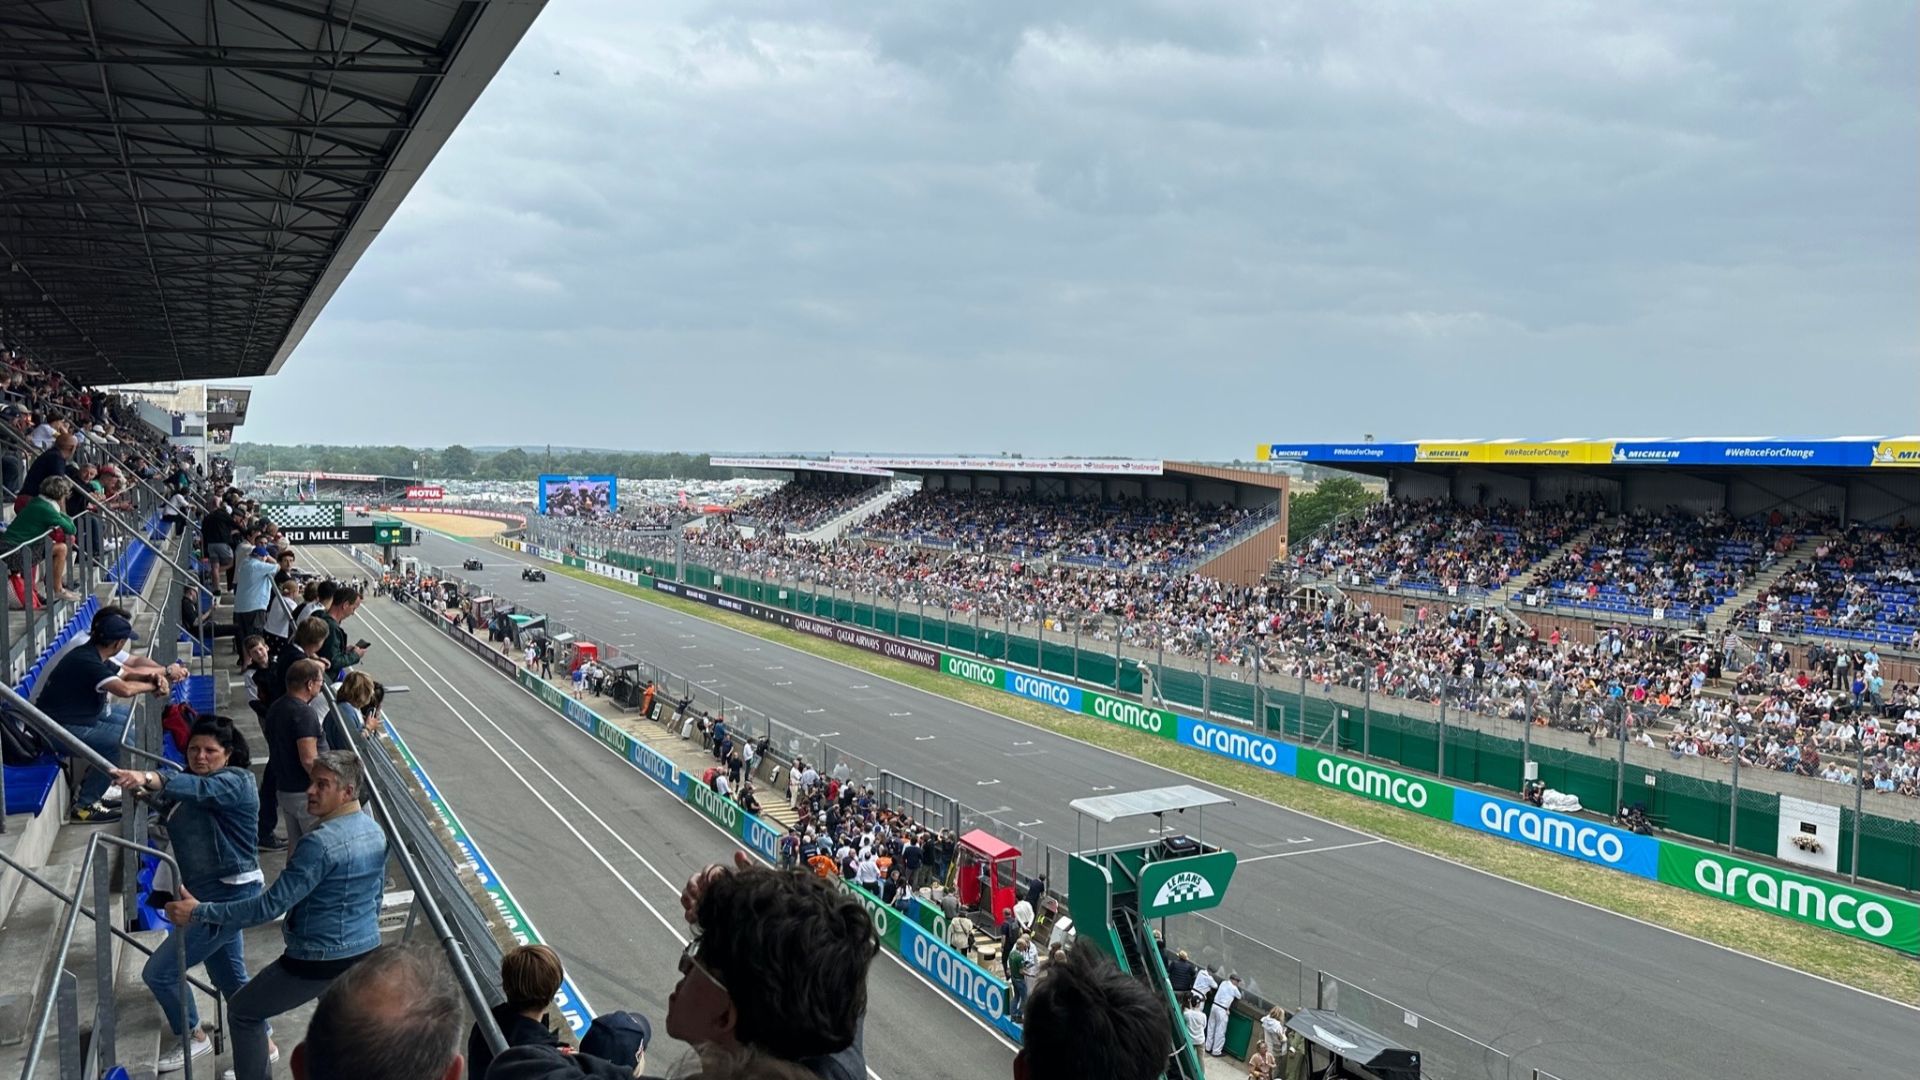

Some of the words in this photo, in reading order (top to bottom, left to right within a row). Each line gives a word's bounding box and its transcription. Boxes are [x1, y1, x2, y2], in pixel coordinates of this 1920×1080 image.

[1504, 448, 1570, 458] #WeRaceForChange
[1628, 450, 1680, 458] MICHELIN
[1725, 447, 1814, 459] #WeRaceForChange
[408, 489, 442, 498] MOTUL
[285, 531, 304, 541] RD
[309, 531, 349, 540] MILLE
[794, 618, 811, 632] QATAR
[812, 622, 833, 637] AIRWAYS
[836, 629, 855, 643] QATAR
[855, 635, 880, 650] AIRWAYS
[884, 642, 906, 659] QATAR
[906, 649, 935, 666] AIRWAYS
[948, 657, 996, 685] aramco
[1014, 675, 1069, 706] aramco
[568, 699, 591, 728] aramco
[1094, 697, 1162, 732] aramco
[599, 720, 626, 751] aramco
[1192, 723, 1277, 766] aramco
[635, 745, 666, 779] aramco
[1317, 758, 1428, 808] aramco
[694, 783, 736, 828] aramco
[1480, 801, 1624, 863] aramco
[1694, 859, 1893, 937] aramco
[914, 934, 1003, 1020] aramco
